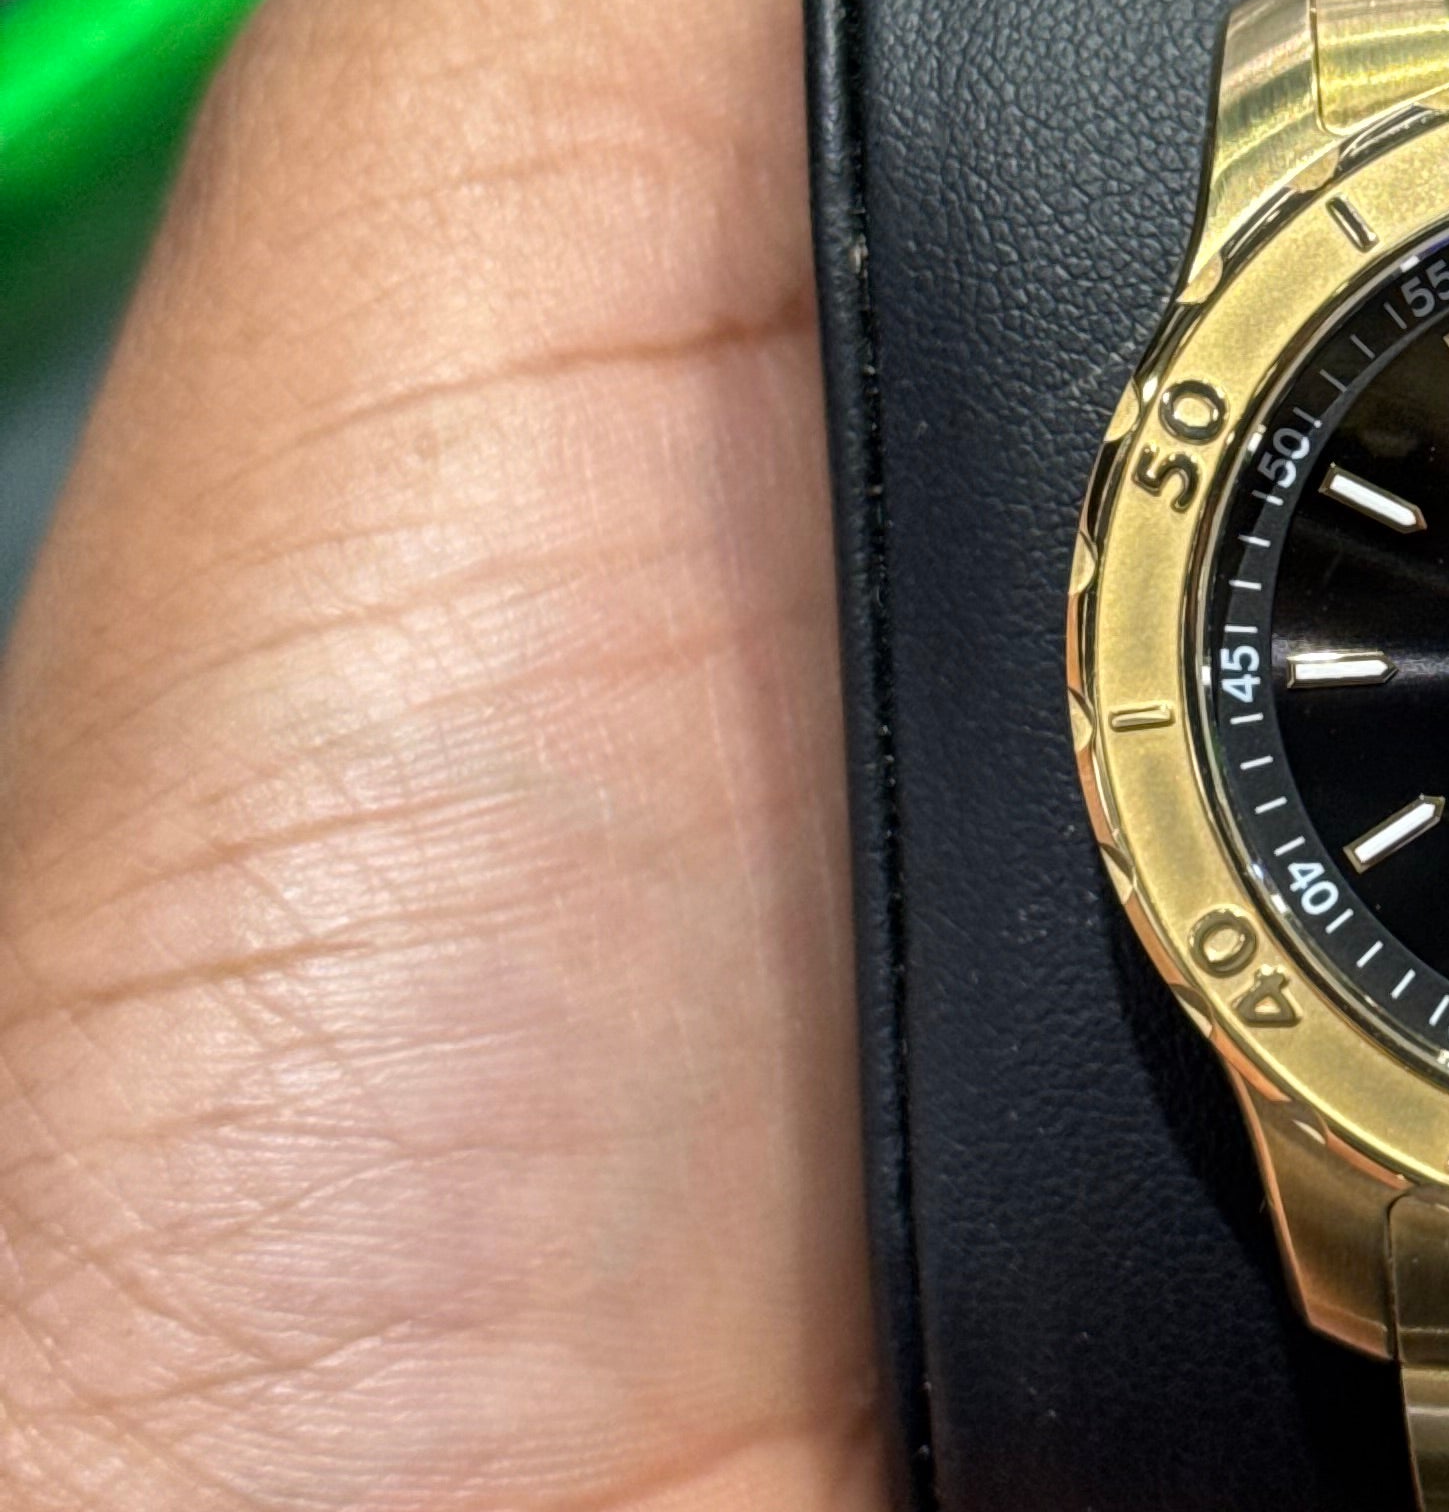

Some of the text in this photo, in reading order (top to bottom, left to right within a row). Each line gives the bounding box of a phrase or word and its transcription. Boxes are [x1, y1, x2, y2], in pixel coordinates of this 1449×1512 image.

[1133, 379, 1230, 514] 50
[1257, 426, 1311, 487] 50
[1220, 645, 1261, 703] 45
[1287, 859, 1340, 916] 40
[1186, 906, 1303, 1027] 40
